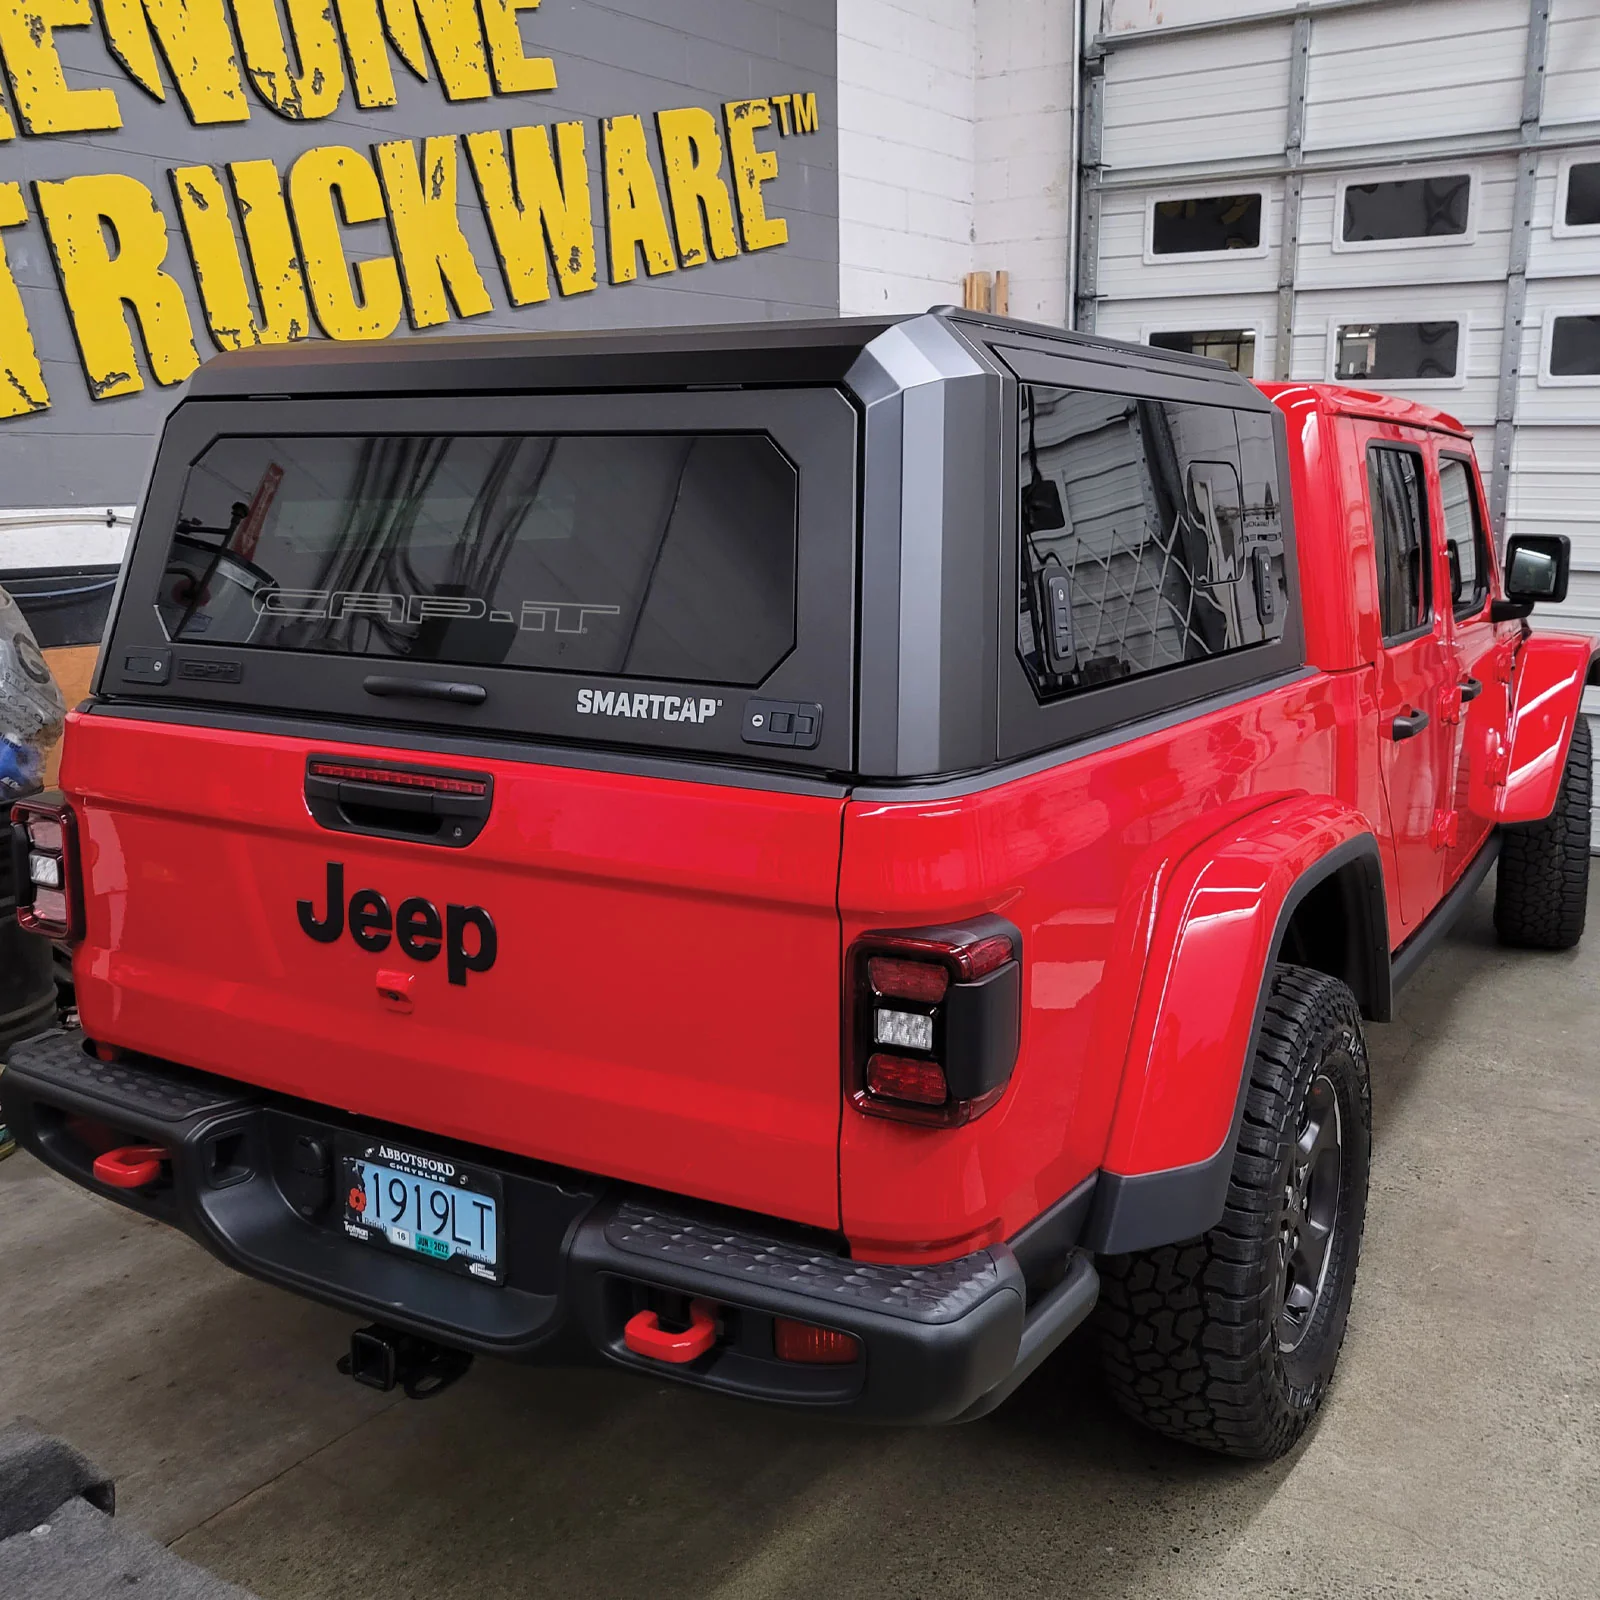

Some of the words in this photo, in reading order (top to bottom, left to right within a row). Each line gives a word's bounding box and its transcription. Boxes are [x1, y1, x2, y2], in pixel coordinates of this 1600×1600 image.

[296, 861, 498, 986] Jeep
[379, 1145, 455, 1177] ABBOTSFORD
[389, 1162, 446, 1183] CHRYSLER
[373, 1172, 493, 1251] 1919LT
[417, 1237, 429, 1248] JUN
[433, 1241, 449, 1255] 2022
